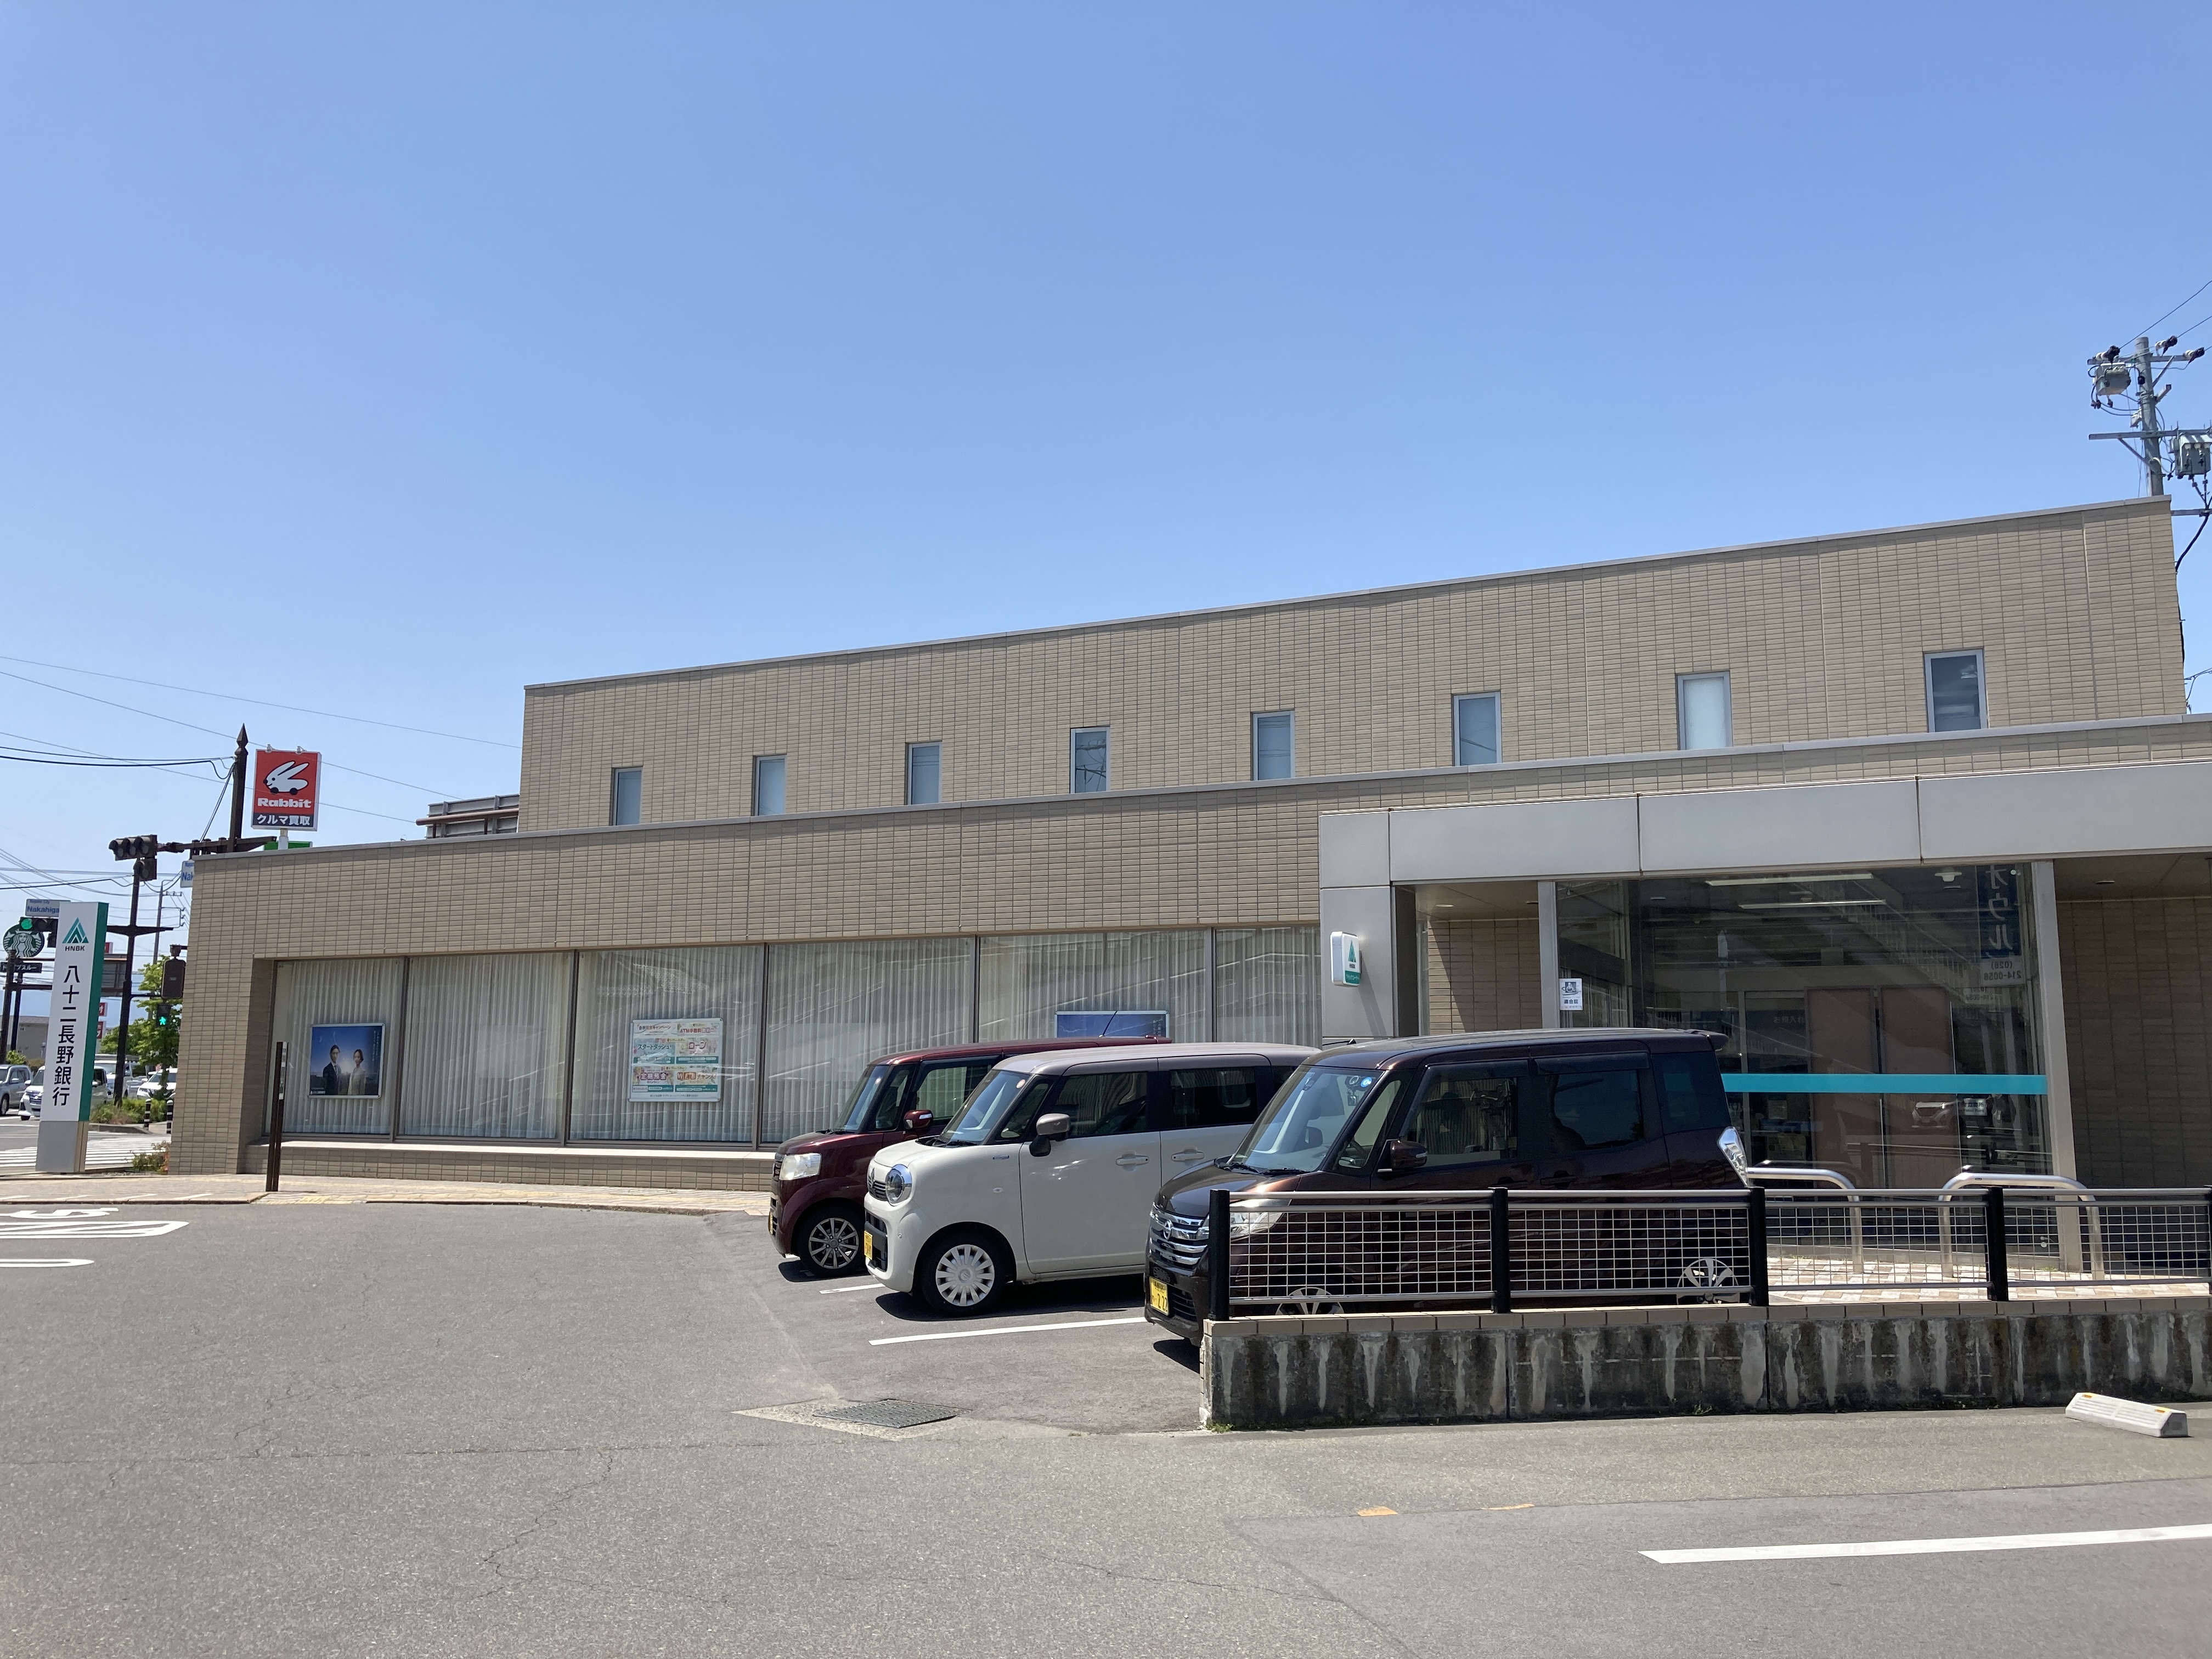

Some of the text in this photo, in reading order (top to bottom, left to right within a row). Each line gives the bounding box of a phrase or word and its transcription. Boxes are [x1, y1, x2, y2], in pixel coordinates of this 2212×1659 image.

[257, 798, 312, 808] Rabbit
[257, 814, 310, 826] クルマ買取
[52, 965, 80, 1107] 八十二長野銀行
[689, 1041, 707, 1049] ローン
